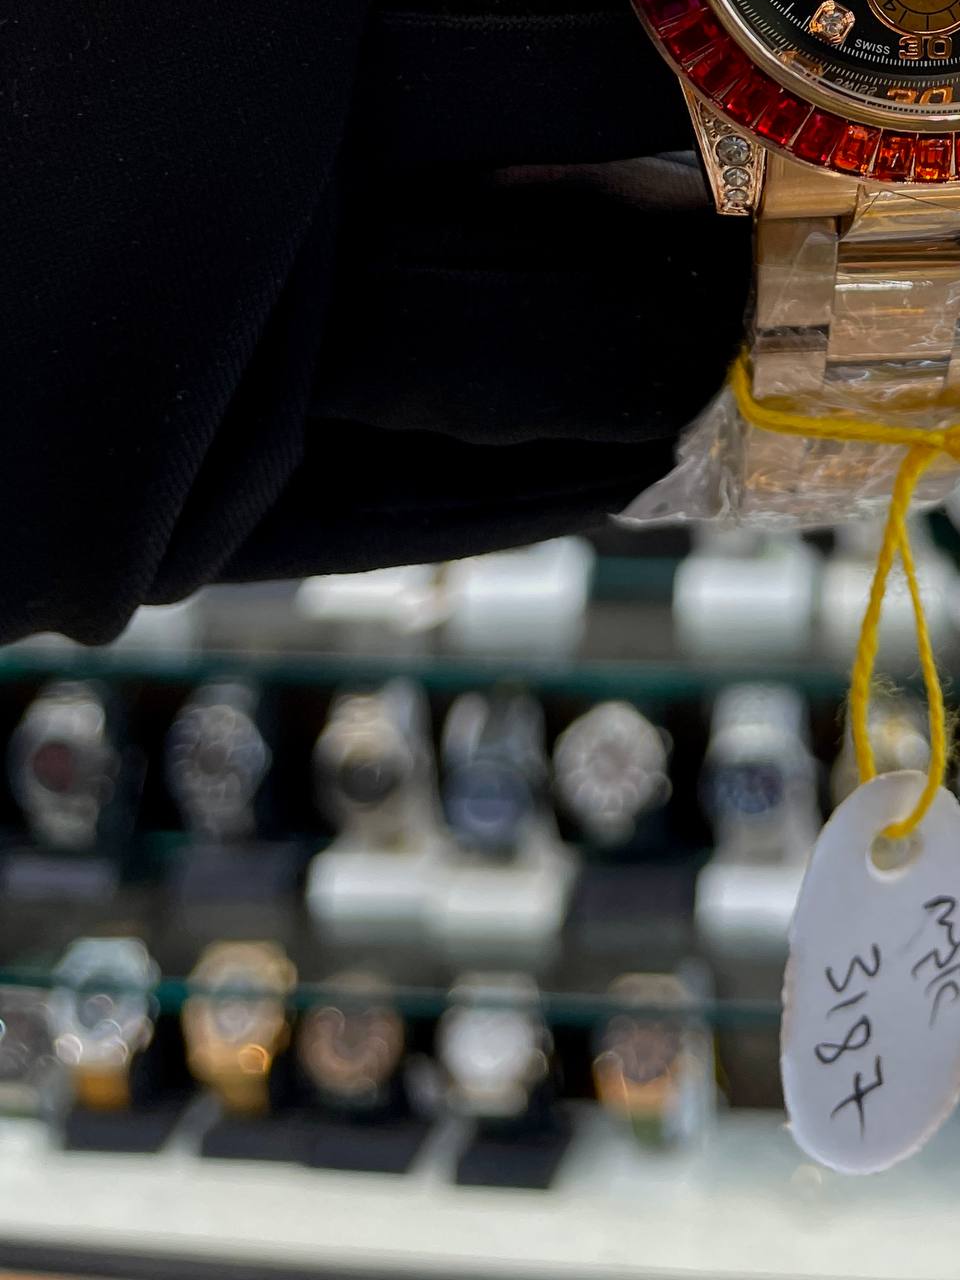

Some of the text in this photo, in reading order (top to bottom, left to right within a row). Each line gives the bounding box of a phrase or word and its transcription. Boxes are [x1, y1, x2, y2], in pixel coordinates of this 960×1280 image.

[855, 38, 892, 56] SWISS
[898, 35, 953, 61] 30
[815, 943, 884, 1141] 3187
